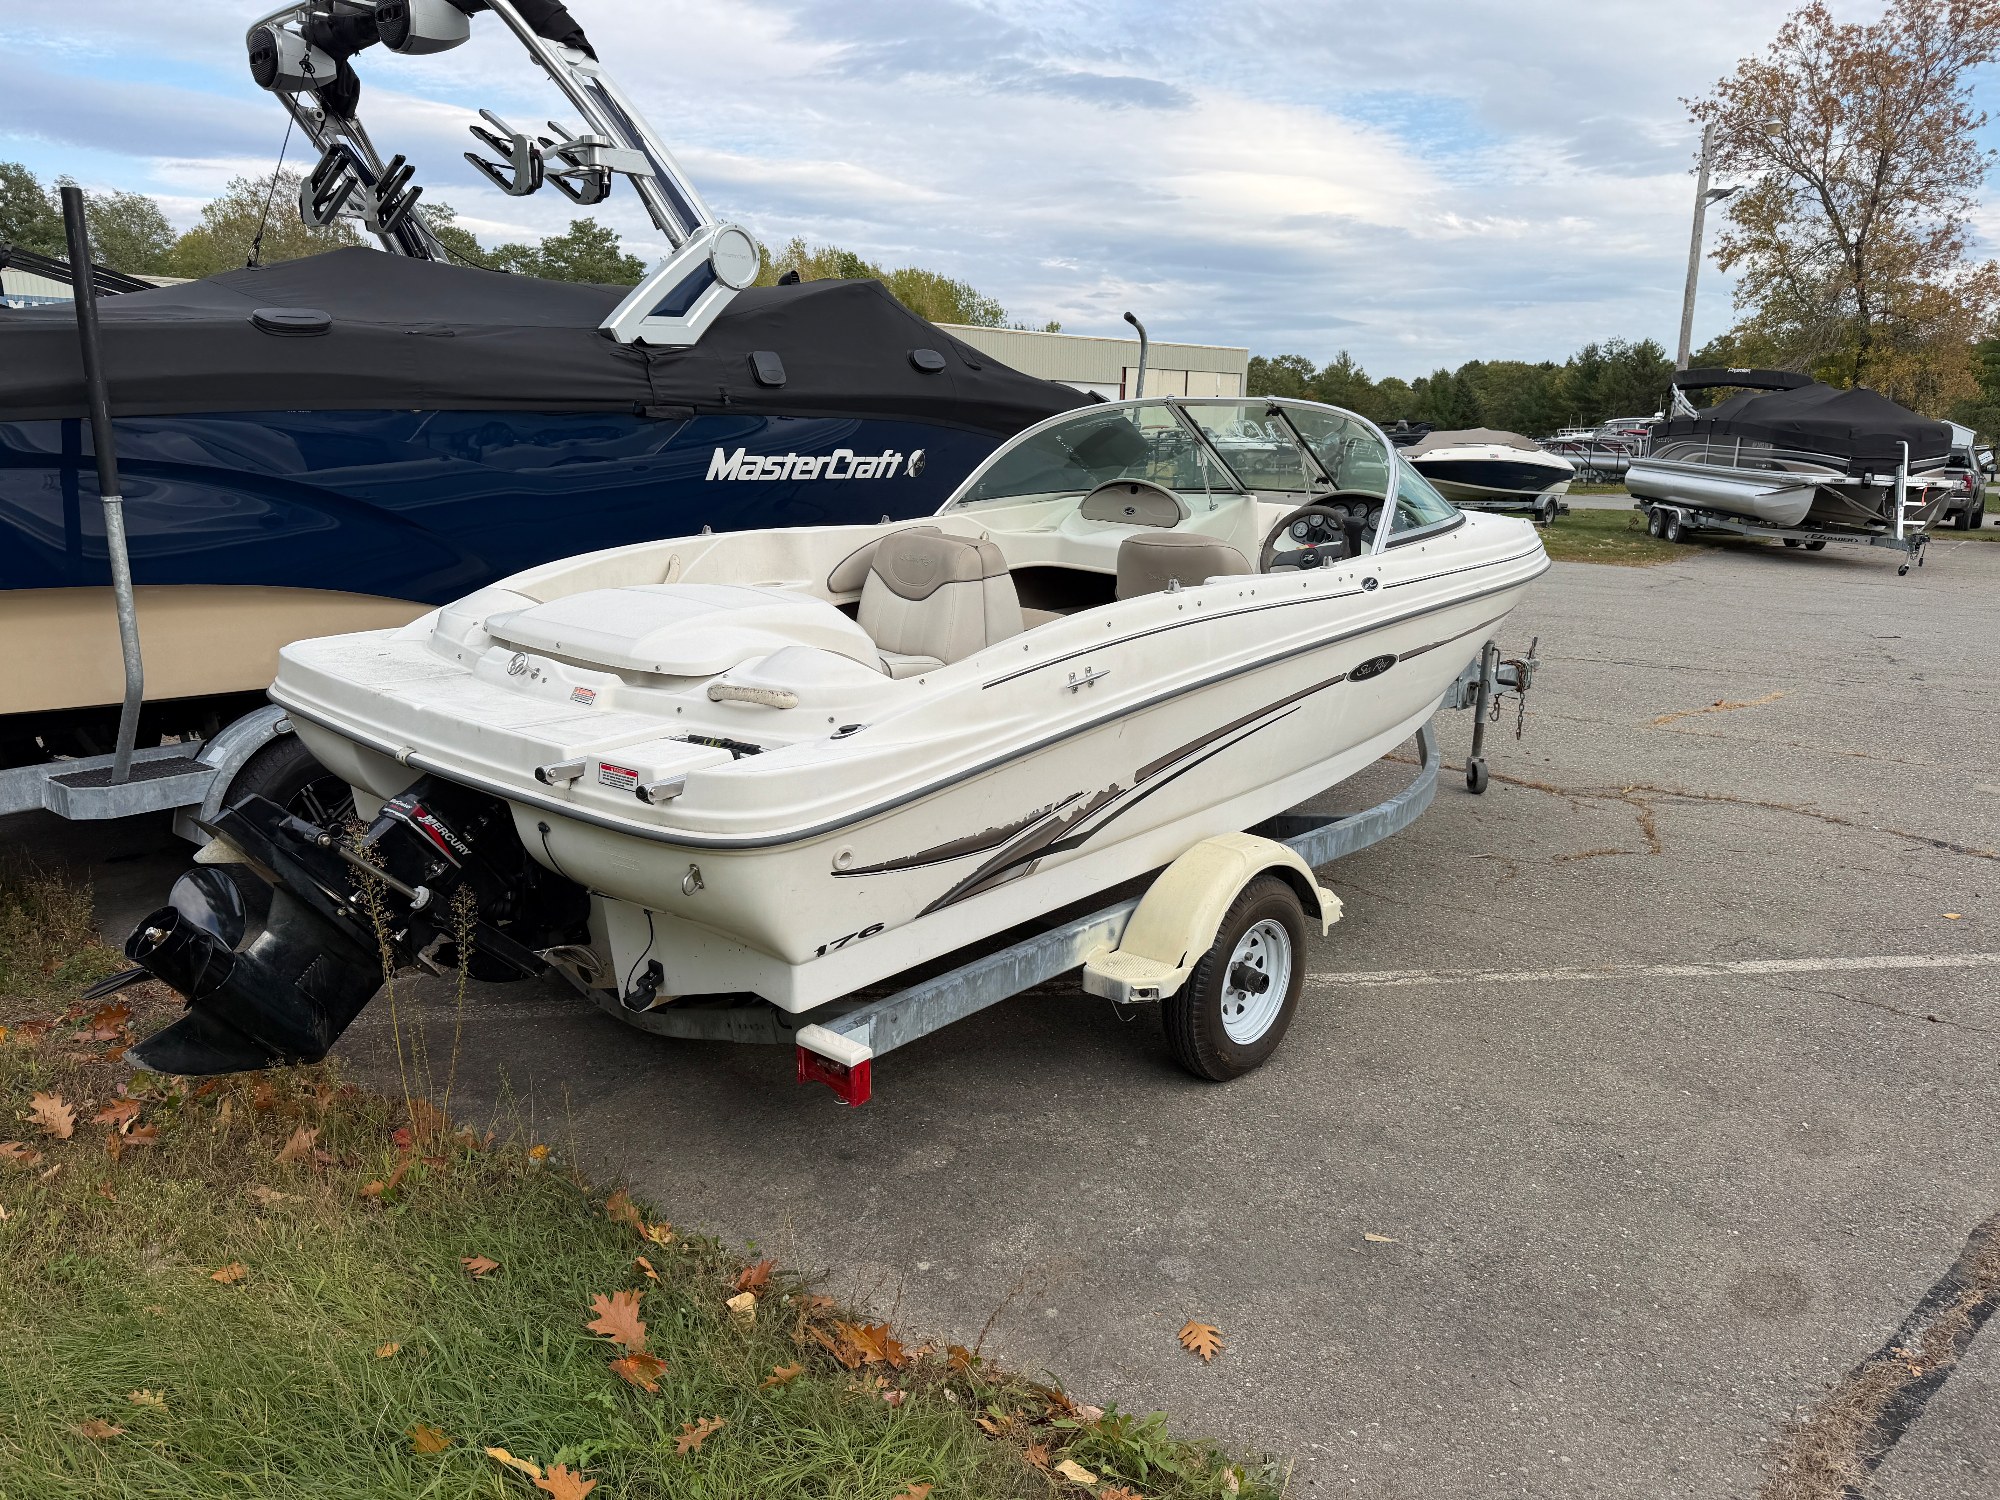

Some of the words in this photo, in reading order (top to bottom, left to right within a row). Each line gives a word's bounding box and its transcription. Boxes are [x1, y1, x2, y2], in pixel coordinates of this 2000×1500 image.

[705, 447, 903, 481] MasterCraft
[416, 814, 473, 856] MERCURY
[813, 922, 885, 958] 176
